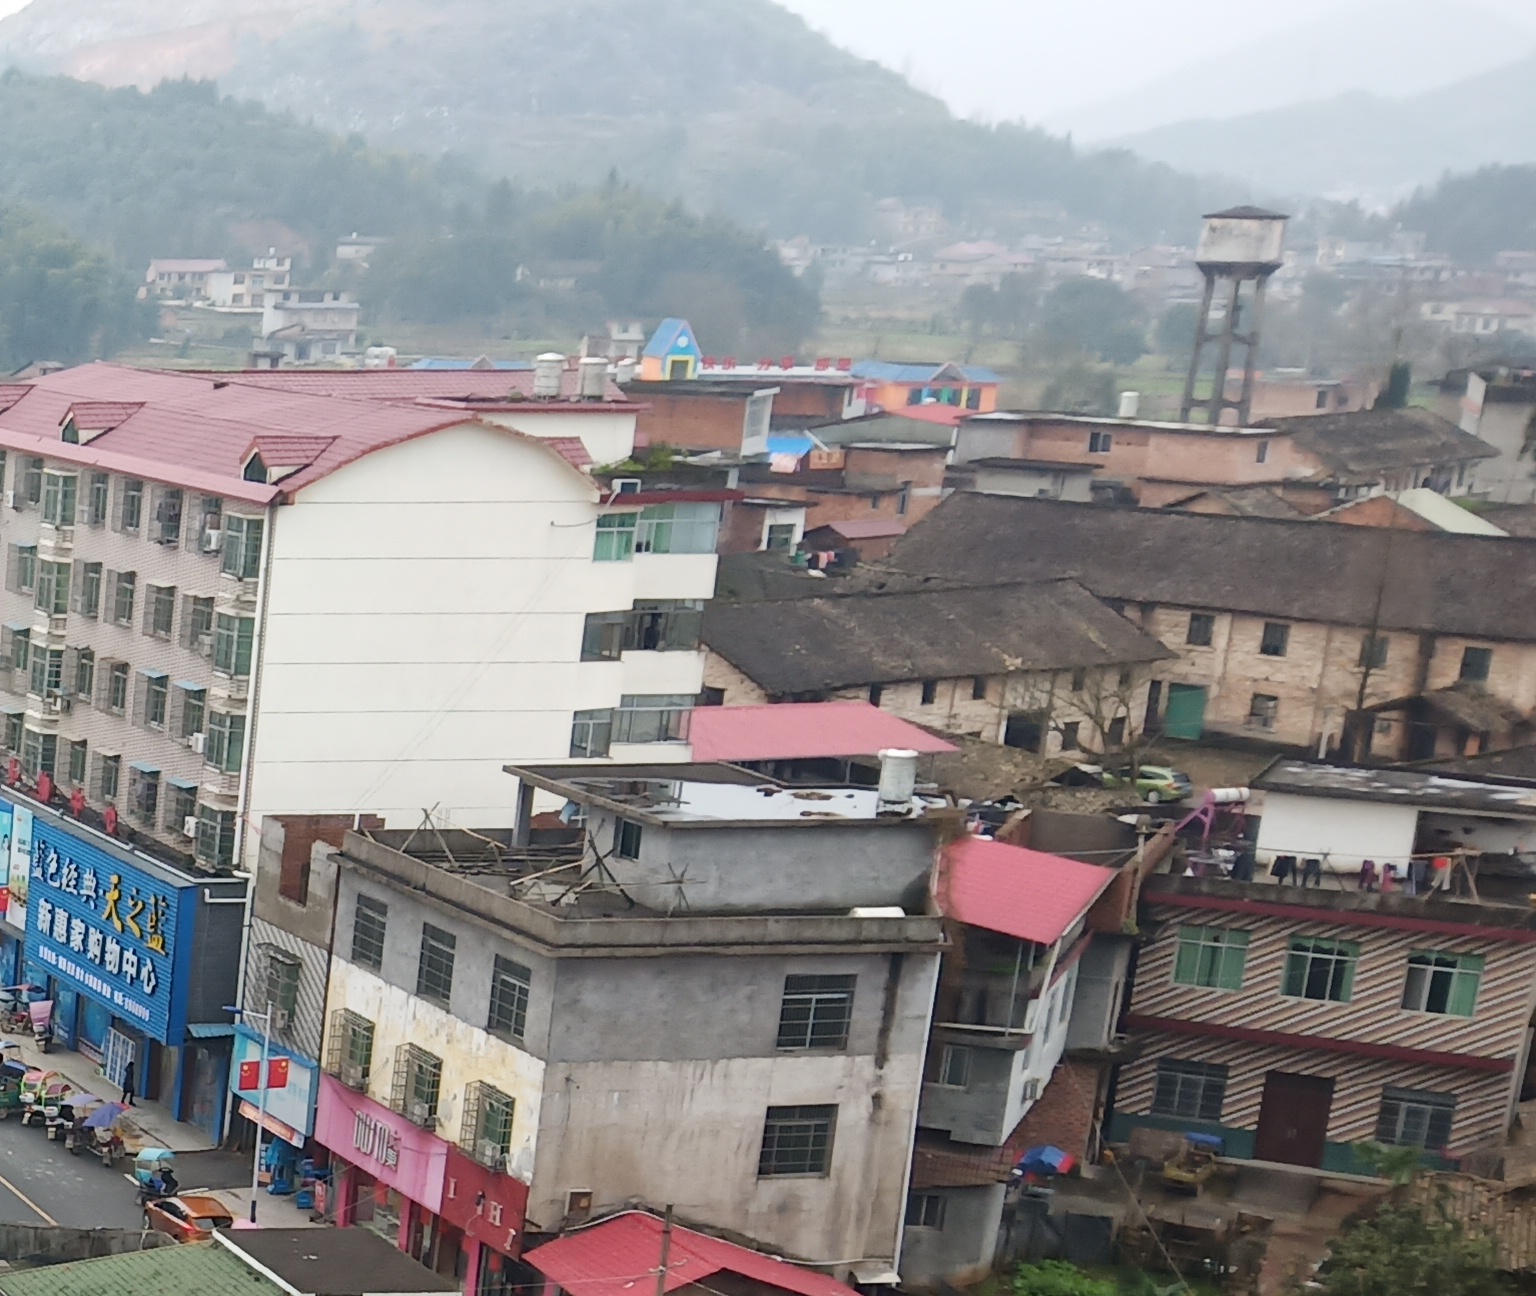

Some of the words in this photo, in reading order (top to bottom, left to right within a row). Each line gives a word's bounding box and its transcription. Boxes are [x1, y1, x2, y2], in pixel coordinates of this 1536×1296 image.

[37, 898, 157, 995] 新惠家购物中心
